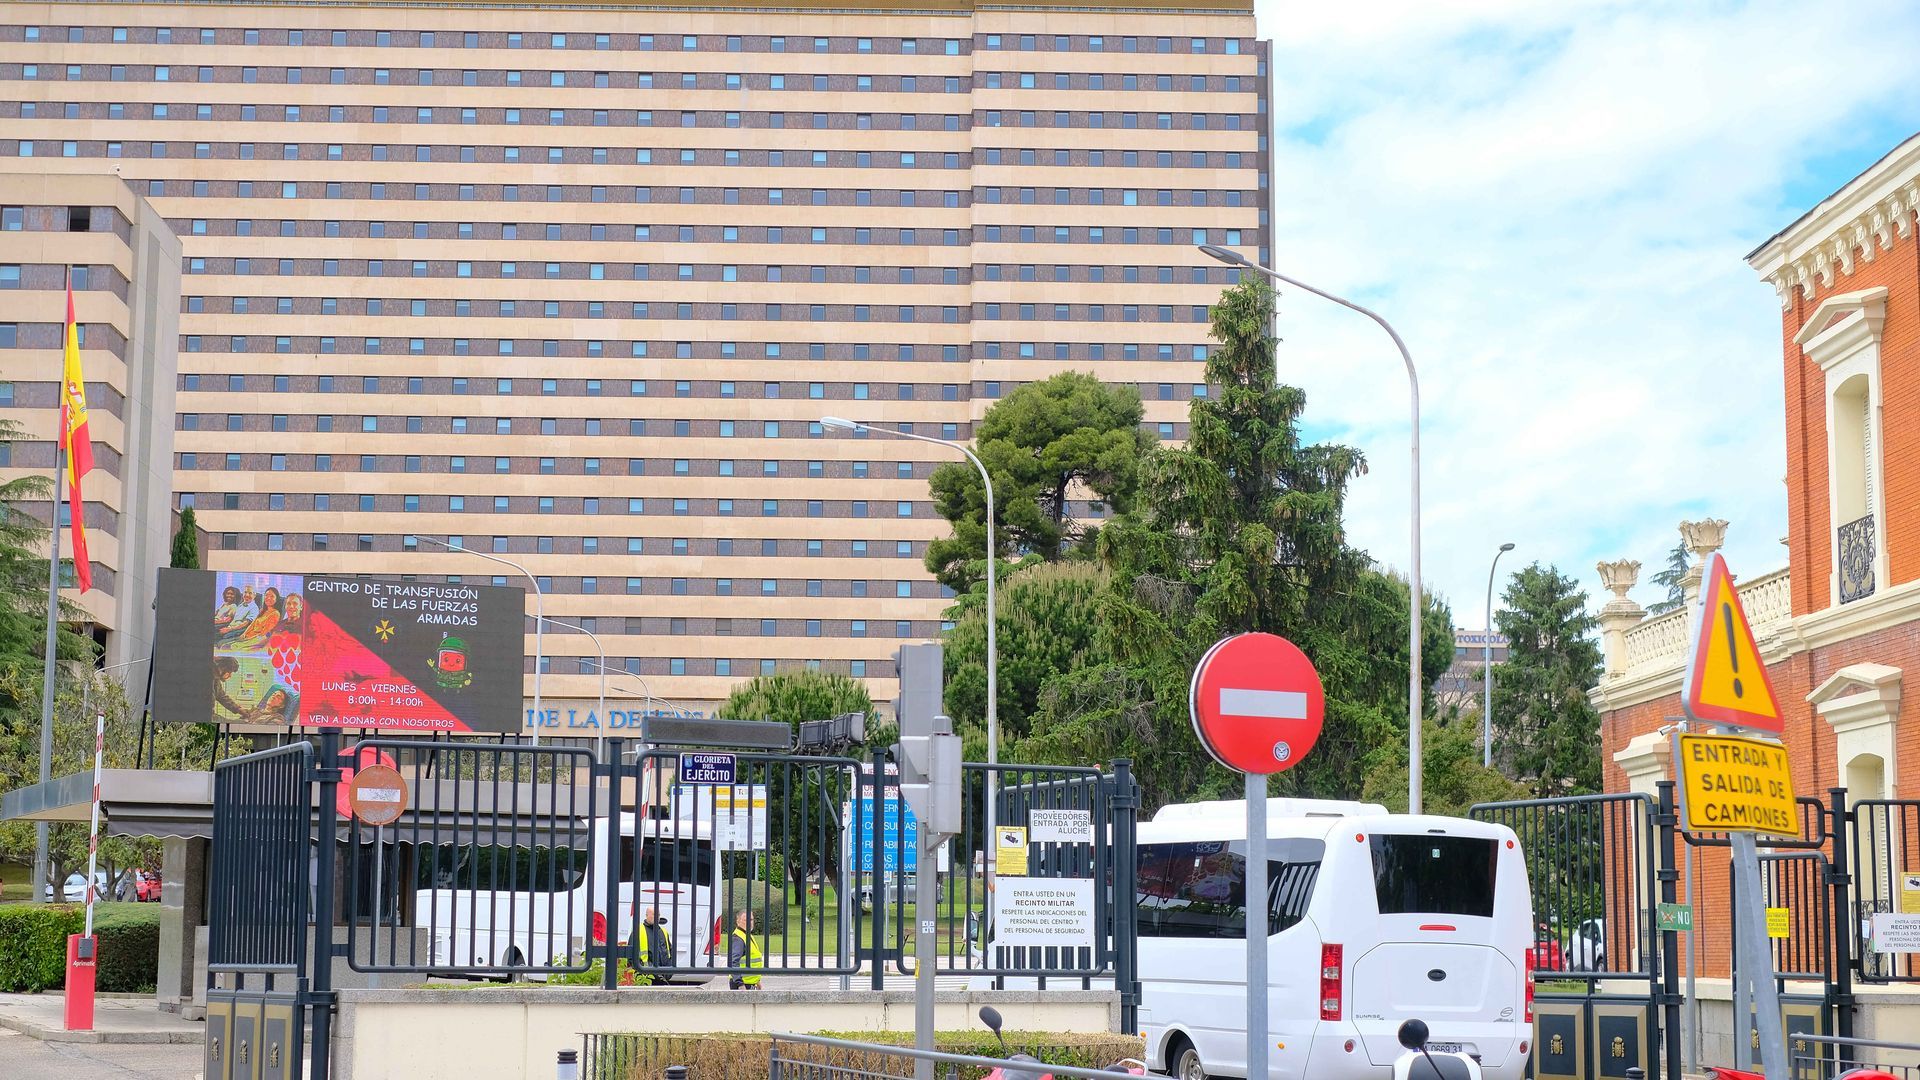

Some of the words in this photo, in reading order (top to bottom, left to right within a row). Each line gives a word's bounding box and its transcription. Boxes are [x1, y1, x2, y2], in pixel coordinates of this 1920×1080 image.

[308, 581, 359, 593] CENTRO
[364, 584, 381, 595] DE
[386, 584, 478, 600] TRANSFUSIÓN
[372, 597, 388, 609] DE
[393, 599, 417, 610] LAS
[421, 600, 478, 613] FUERZAS
[417, 613, 478, 626] ARMADAS
[321, 681, 357, 692] LUNES
[371, 683, 417, 694] VIERNES
[348, 695, 377, 705] 8:00h
[389, 697, 424, 707] 14:00h
[309, 715, 329, 724] VEN
[332, 716, 339, 724] A
[342, 716, 376, 725] DONAR
[379, 717, 400, 726] CON
[402, 718, 455, 728] NOSOTROS
[526, 709, 560, 728] DE
[567, 708, 600, 729] LA
[694, 755, 731, 764] GLORIETA
[1692, 743, 1769, 769] ENTRADA
[1774, 752, 1782, 771] Y
[686, 769, 730, 781] EJERCITO
[1701, 773, 1763, 796] SALIDA
[1768, 780, 1786, 800] DE
[1705, 803, 1789, 828] CAMIONES
[1057, 827, 1088, 835] ALUCHE
[1677, 911, 1690, 925] NO
